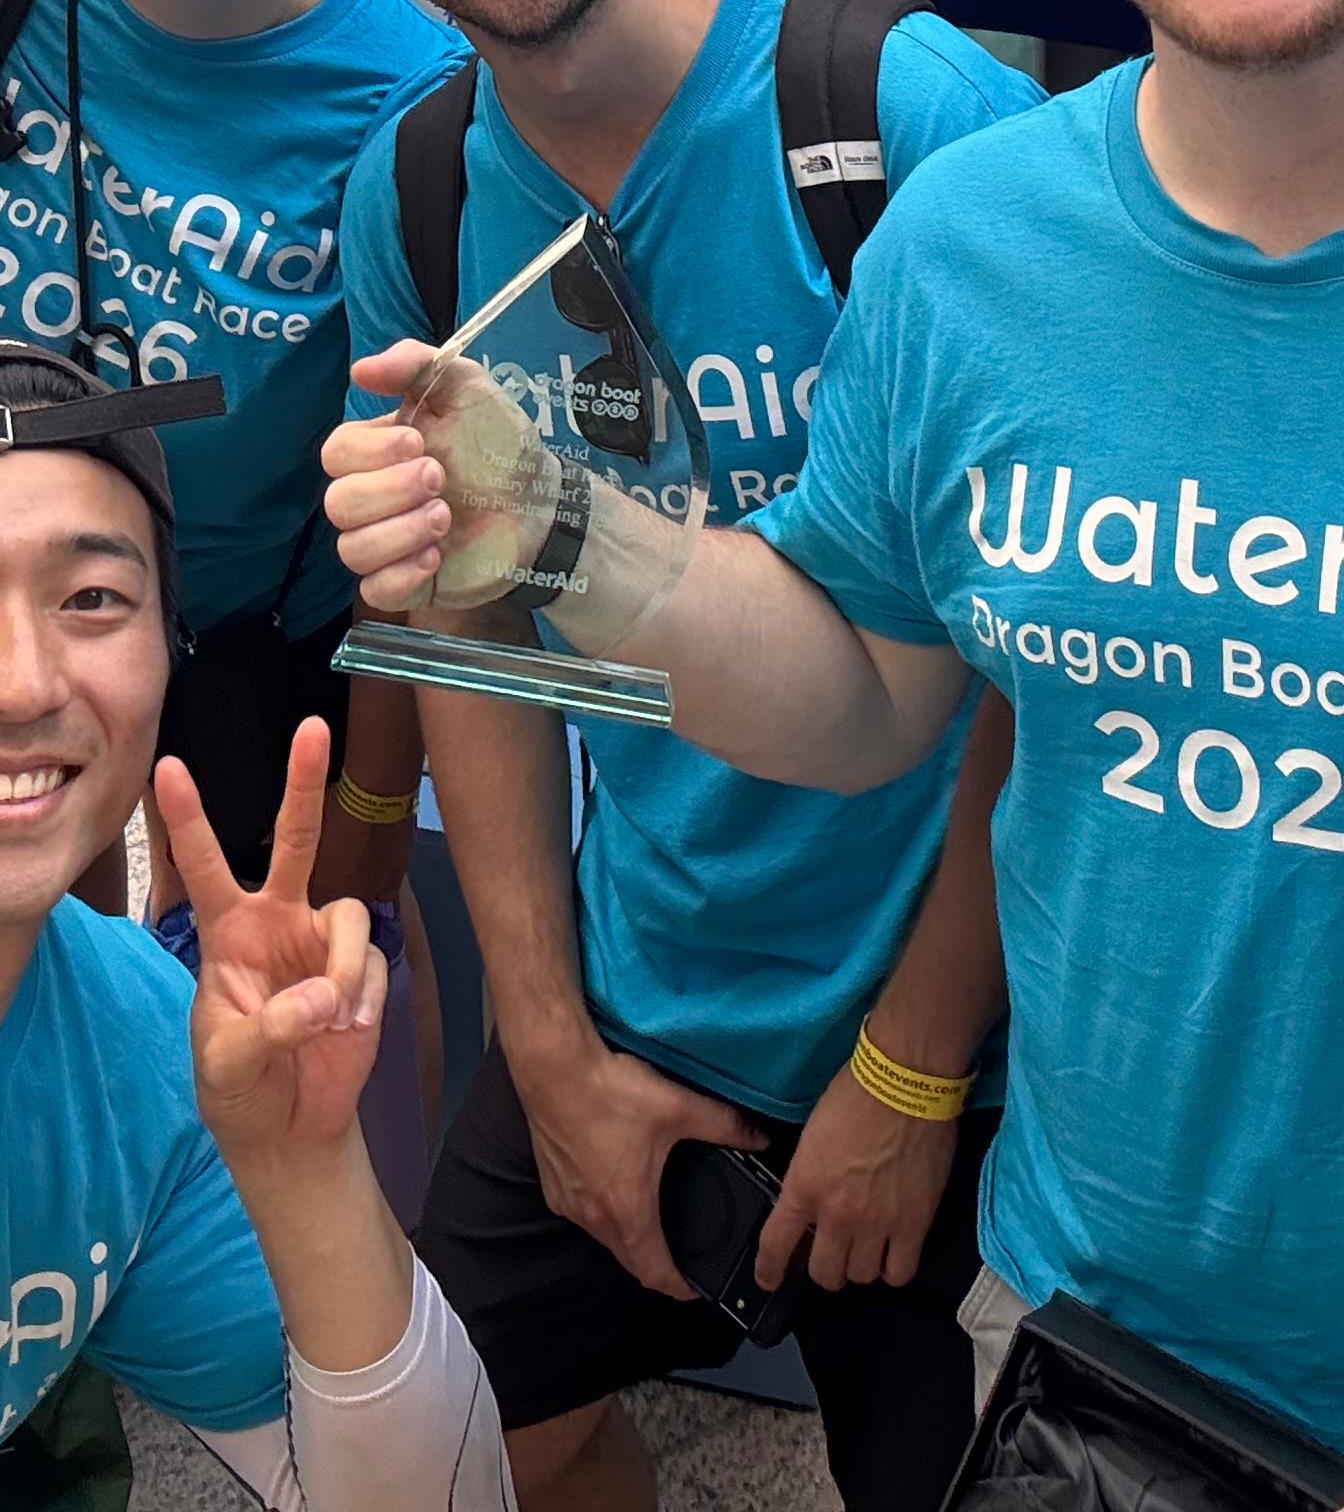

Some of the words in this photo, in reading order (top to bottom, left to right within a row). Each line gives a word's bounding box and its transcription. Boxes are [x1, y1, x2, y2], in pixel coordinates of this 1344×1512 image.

[86, 221, 181, 305] Boat
[193, 287, 311, 343] Race
[600, 381, 642, 404] boat
[482, 448, 536, 474] Dragon
[460, 489, 488, 511] Top
[532, 479, 580, 503] Wharf
[971, 595, 1192, 687] Dragon
